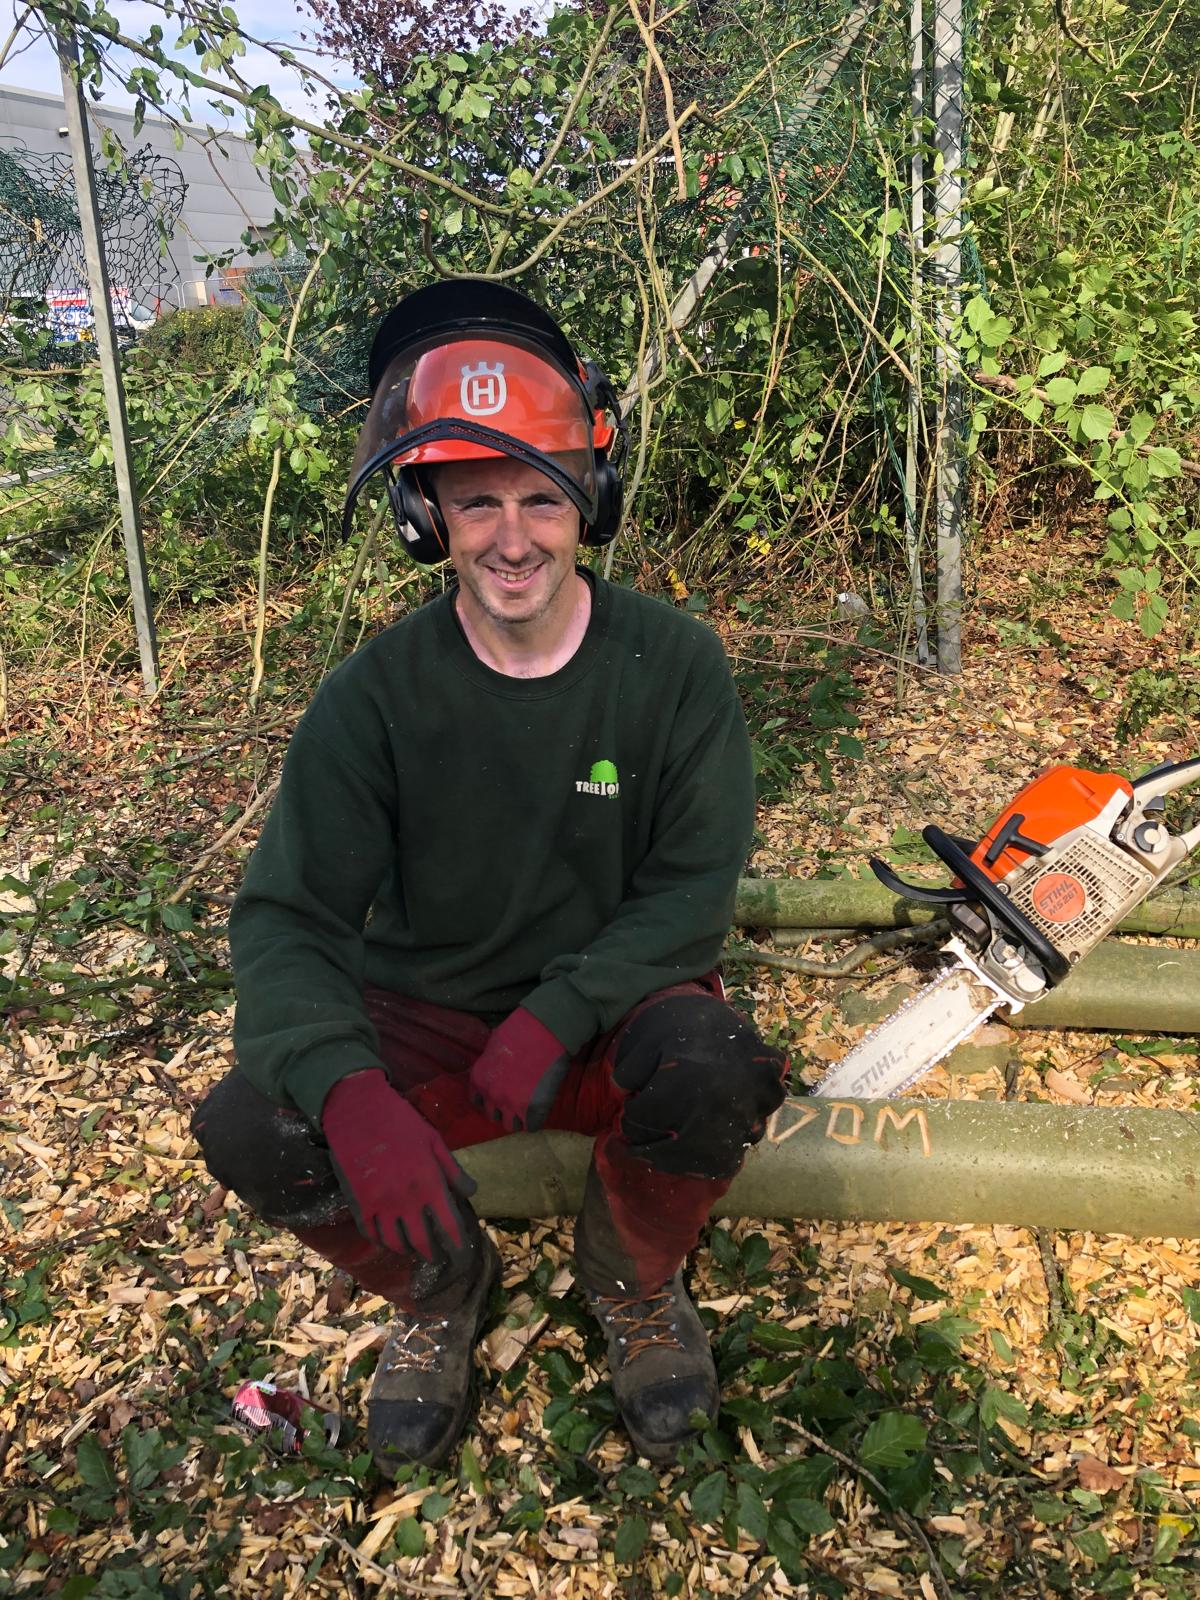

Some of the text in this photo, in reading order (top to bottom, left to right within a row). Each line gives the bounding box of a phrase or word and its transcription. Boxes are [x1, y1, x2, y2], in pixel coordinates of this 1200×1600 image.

[472, 378, 495, 406] H
[1040, 880, 1073, 910] STIHL
[851, 1049, 904, 1097] STIHL
[766, 1100, 931, 1158] DOM
